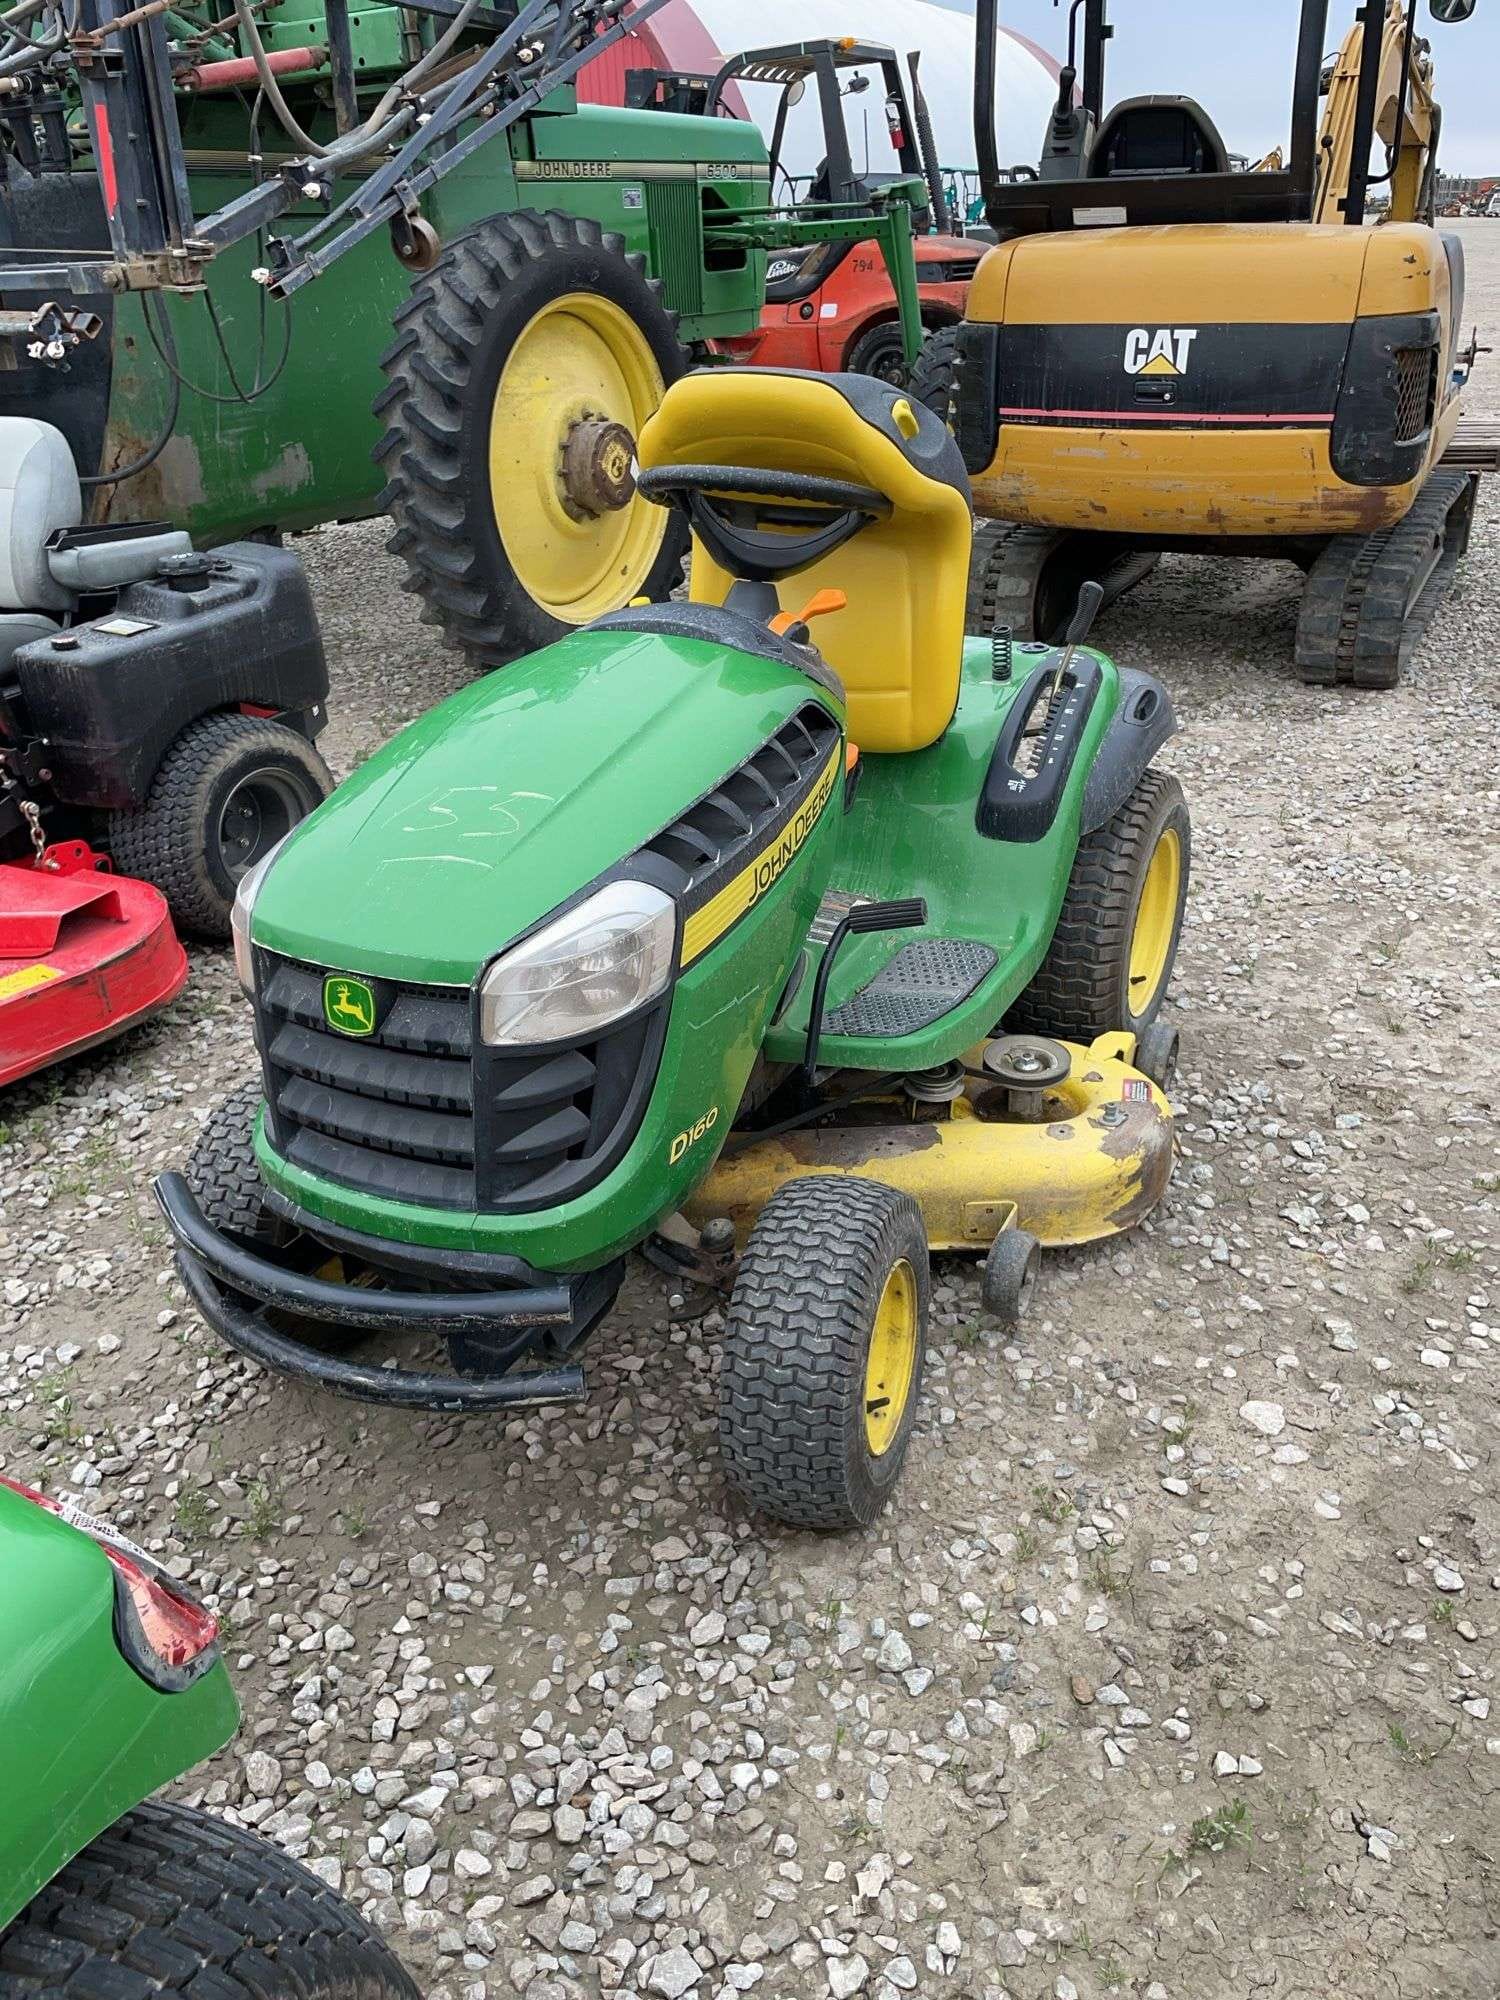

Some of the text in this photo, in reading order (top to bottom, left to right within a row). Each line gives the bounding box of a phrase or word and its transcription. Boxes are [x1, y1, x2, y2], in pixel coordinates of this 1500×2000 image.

[535, 162, 611, 177] JOHN DEERE
[1123, 328, 1198, 375] CAT
[749, 768, 832, 903] JOHN DEERE
[669, 1106, 719, 1165] D160
